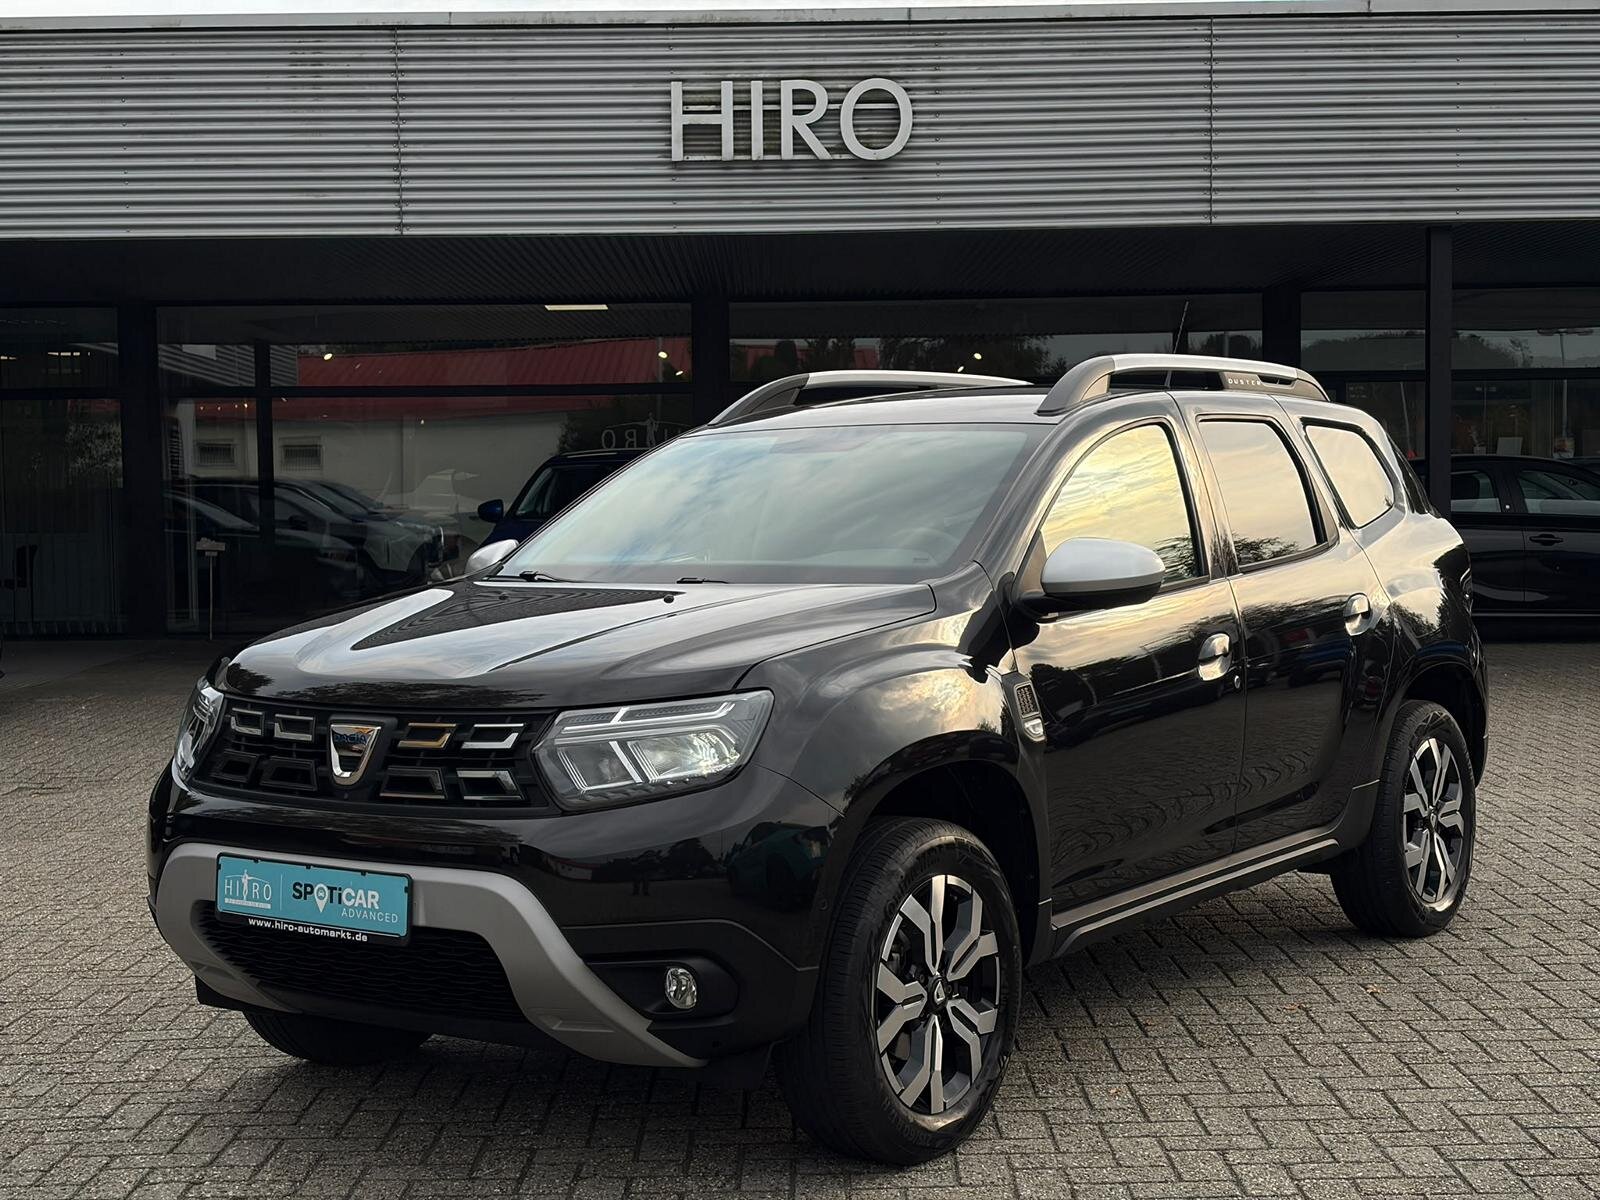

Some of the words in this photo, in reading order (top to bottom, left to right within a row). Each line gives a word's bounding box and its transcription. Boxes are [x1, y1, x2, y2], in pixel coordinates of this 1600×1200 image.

[671, 77, 913, 162] HIRO
[224, 878, 272, 901] HIRO
[341, 908, 398, 923] ADVANCED
[248, 918, 368, 942] www.hiro-automarkt.de
